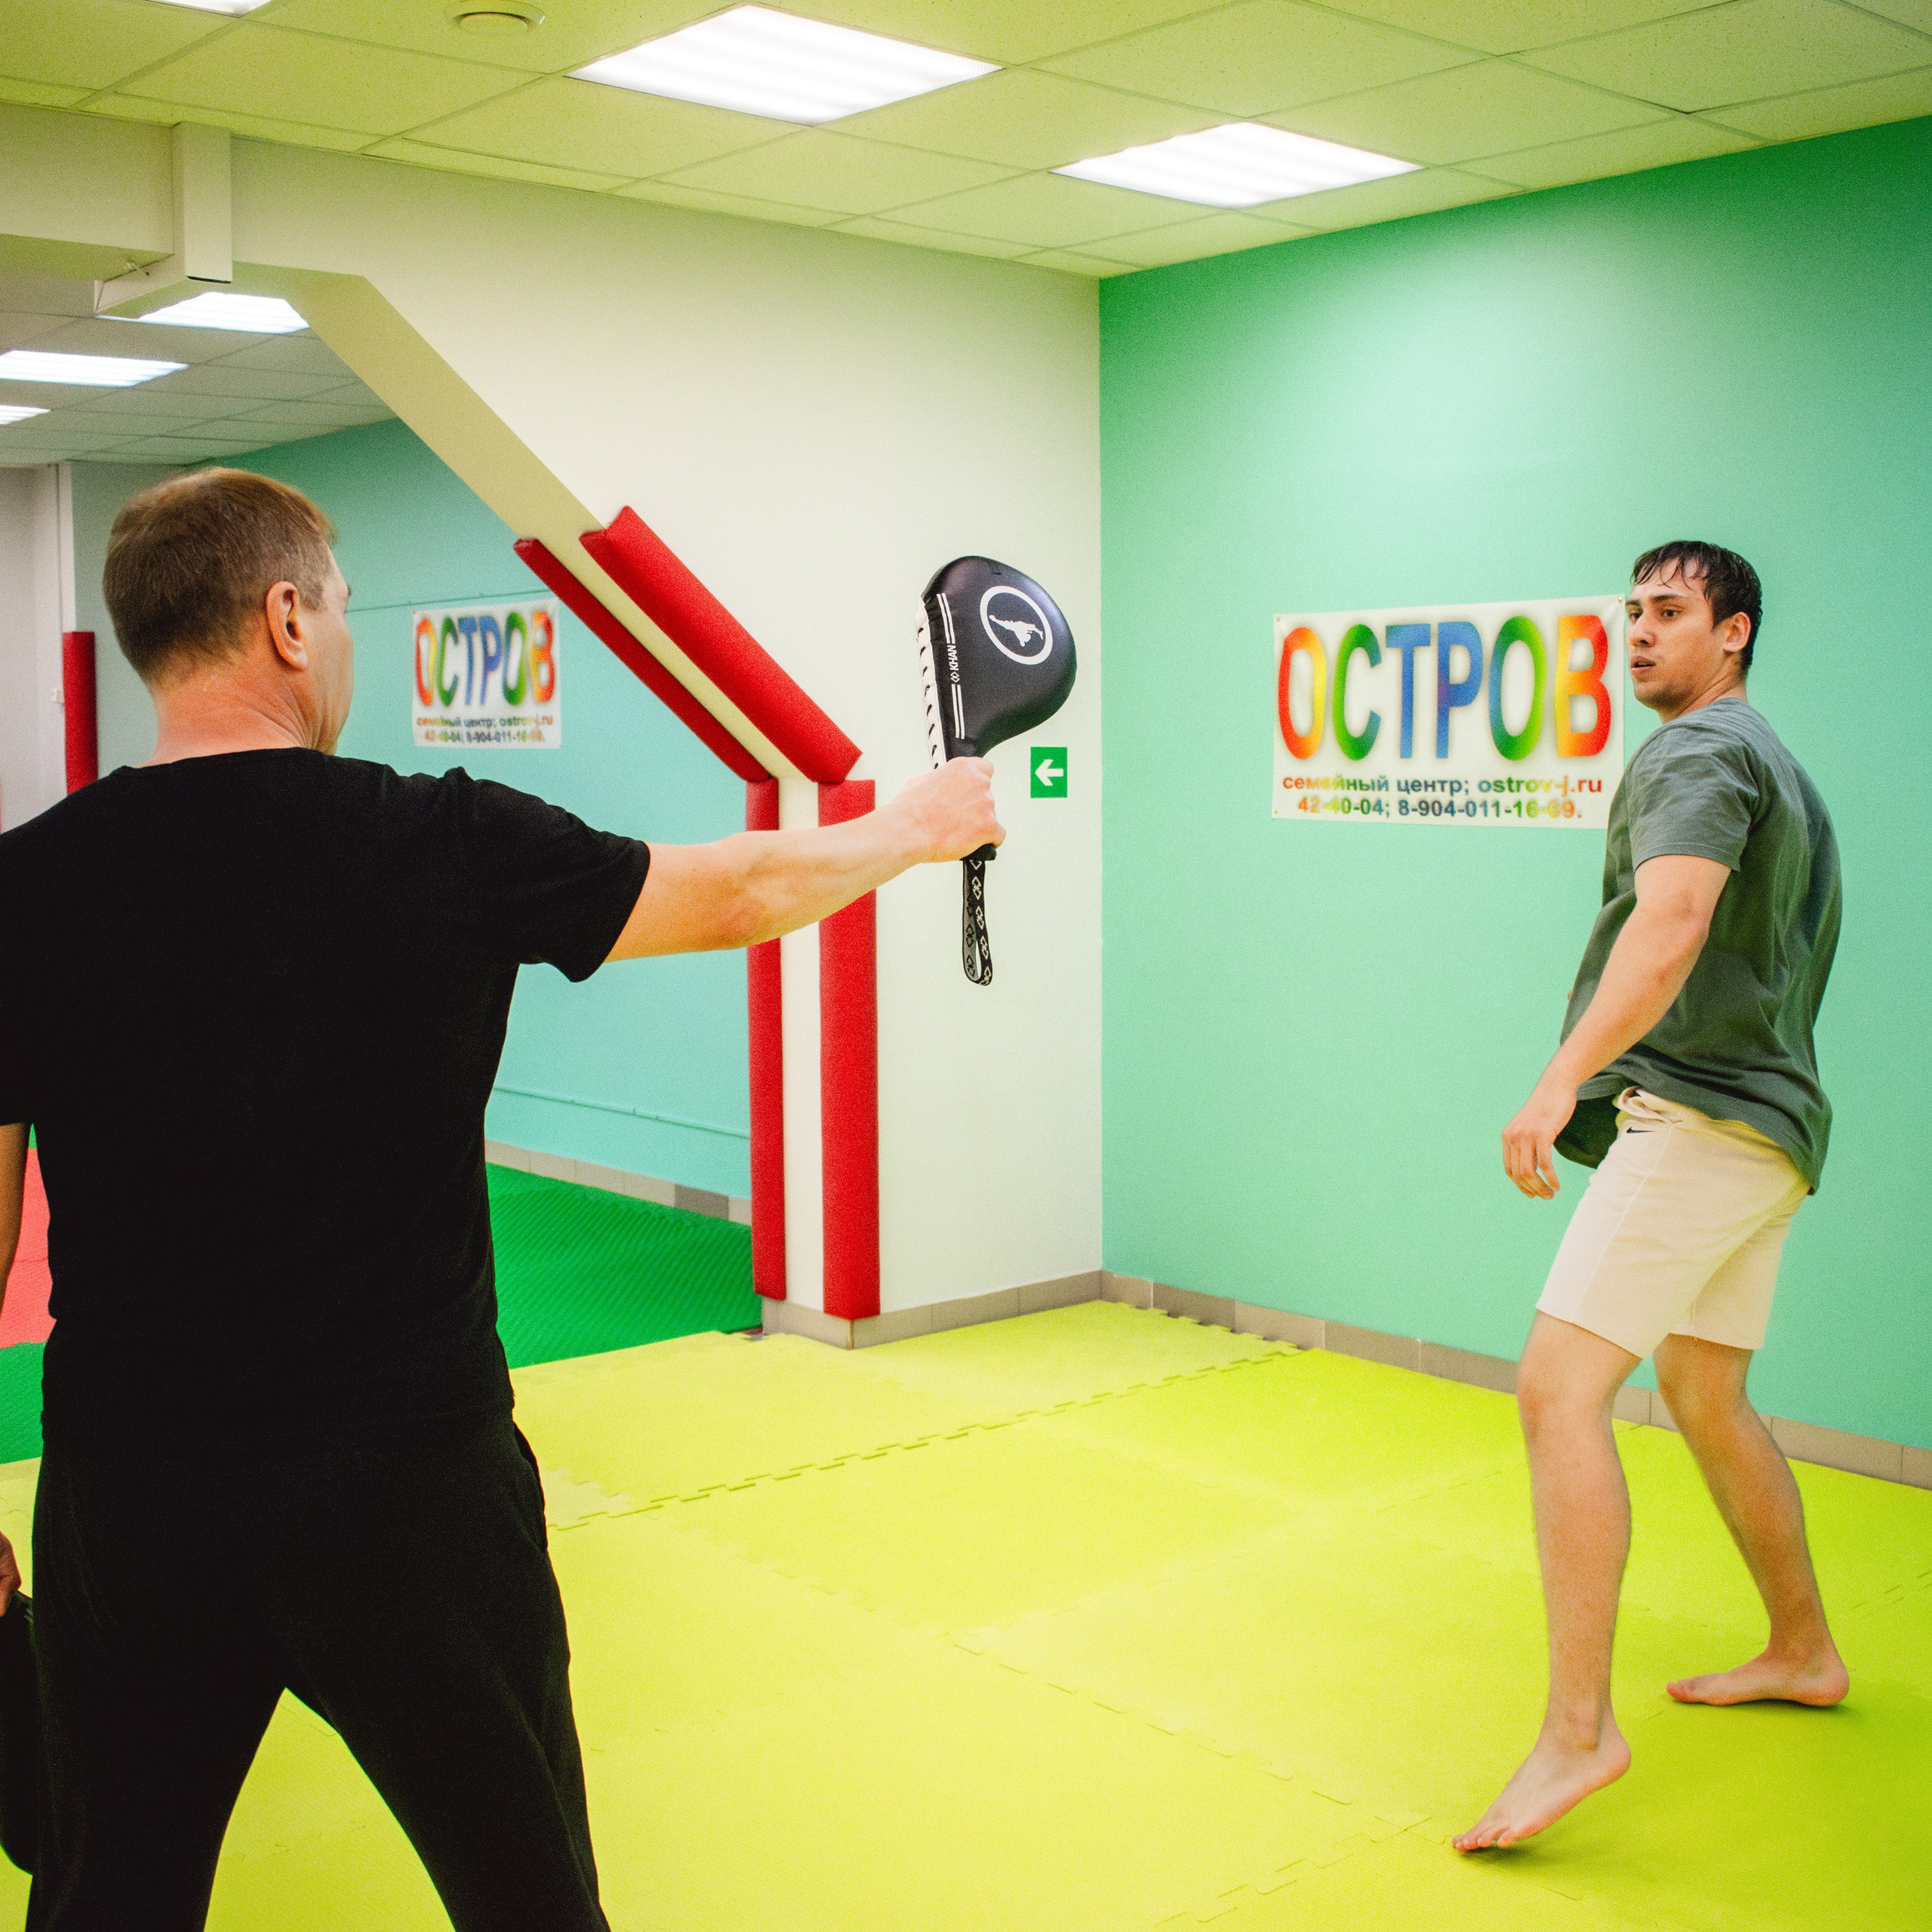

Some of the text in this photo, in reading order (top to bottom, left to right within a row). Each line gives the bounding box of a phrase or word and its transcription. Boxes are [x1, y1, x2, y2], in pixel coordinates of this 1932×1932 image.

[416, 611, 555, 706] ОСТРОВ
[946, 645, 959, 671] KHAN
[1278, 614, 1611, 761] ОСТРОВ
[1282, 774, 1602, 798] семейный центр; ostrov-j.ru
[1297, 796, 1582, 819] 42-40-04; 8-904-011-16-69.
